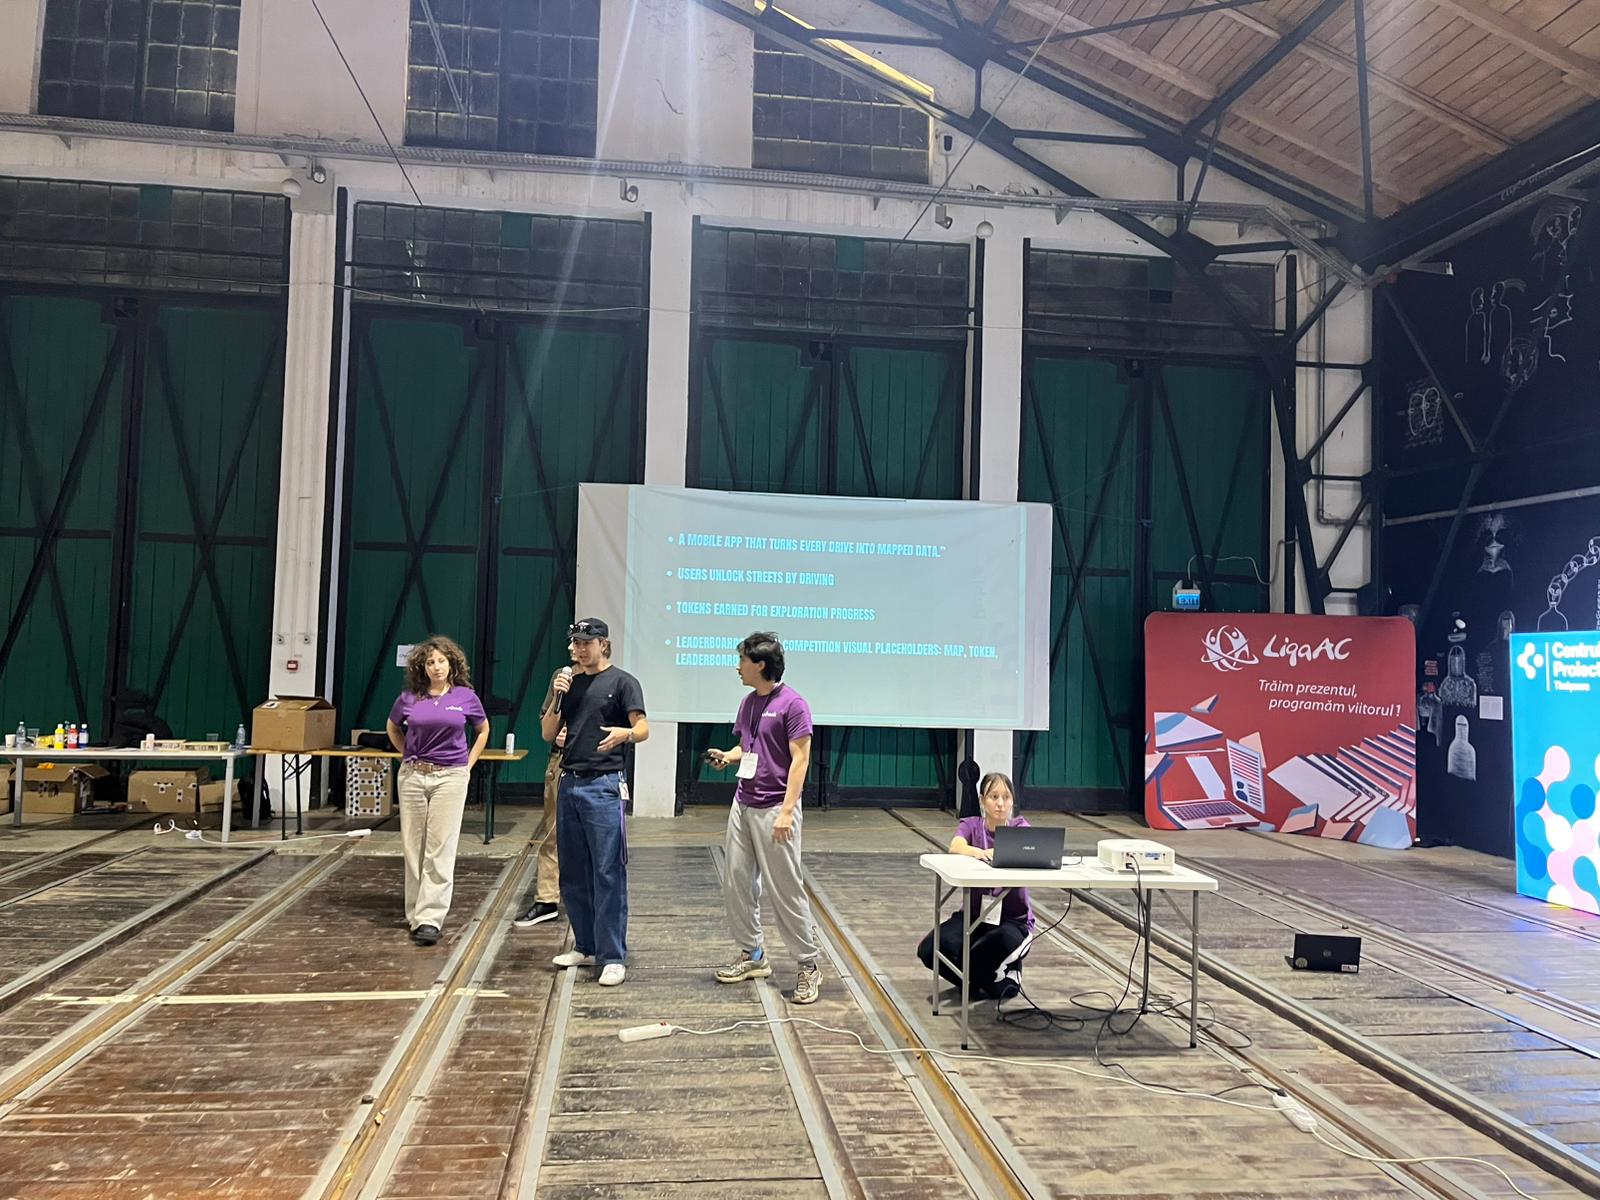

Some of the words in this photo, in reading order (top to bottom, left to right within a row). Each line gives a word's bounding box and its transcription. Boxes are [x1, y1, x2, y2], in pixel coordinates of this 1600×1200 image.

[679, 533, 686, 545] A
[687, 534, 722, 547] MOBILE
[724, 535, 743, 548] APP
[745, 536, 767, 549] THAT
[769, 538, 798, 551] TURNS
[800, 539, 827, 552] EVERY
[829, 541, 854, 553] DRIVE
[856, 542, 875, 554] INTO
[877, 543, 913, 556] MAPPED
[678, 567, 707, 580] USERS
[709, 568, 744, 582] UNLOCK
[746, 570, 783, 583] STREETS
[785, 572, 797, 585] BY
[799, 573, 834, 586] DRIVING
[1178, 596, 1199, 605] EXIT
[677, 601, 711, 614] TOKENS
[714, 603, 749, 616] EARNED
[751, 605, 768, 617] FOR
[770, 606, 828, 619] EXPLORATION
[831, 607, 875, 620] PROGRESS
[676, 636, 744, 649] LEADERBOARD
[783, 640, 841, 653] COMPETITION
[843, 641, 872, 654] VISUAL
[875, 642, 941, 656] PLACEHOLDERS:
[1259, 679, 1293, 693] Trăim
[1296, 683, 1358, 698] prezentul,
[1268, 698, 1345, 713] programăm
